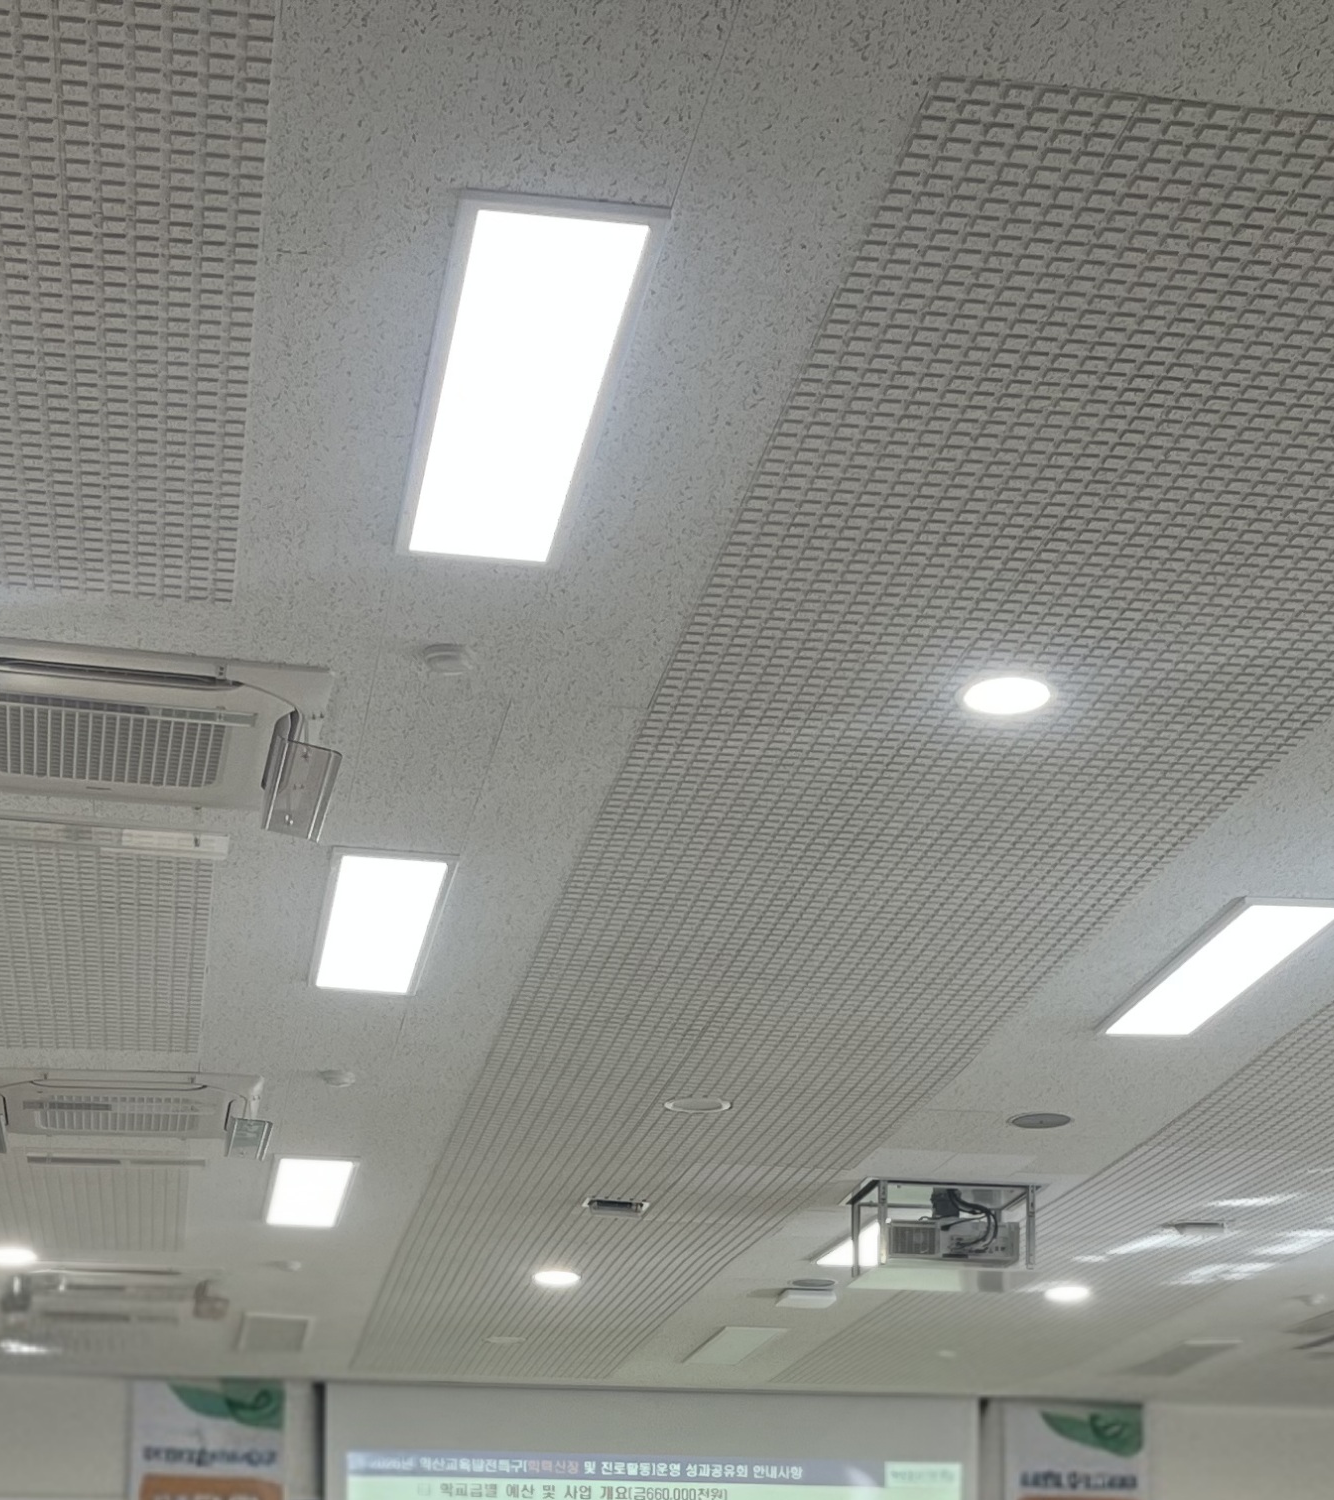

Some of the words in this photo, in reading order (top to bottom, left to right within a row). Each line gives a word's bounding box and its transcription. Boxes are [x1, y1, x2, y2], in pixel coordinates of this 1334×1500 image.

[584, 1461, 596, 1475] 및
[686, 1463, 748, 1478] 성과공유회
[753, 1464, 803, 1480] 안내사항
[505, 1483, 534, 1499] 예산
[542, 1484, 555, 1499] 및
[564, 1485, 592, 1500] 사업
